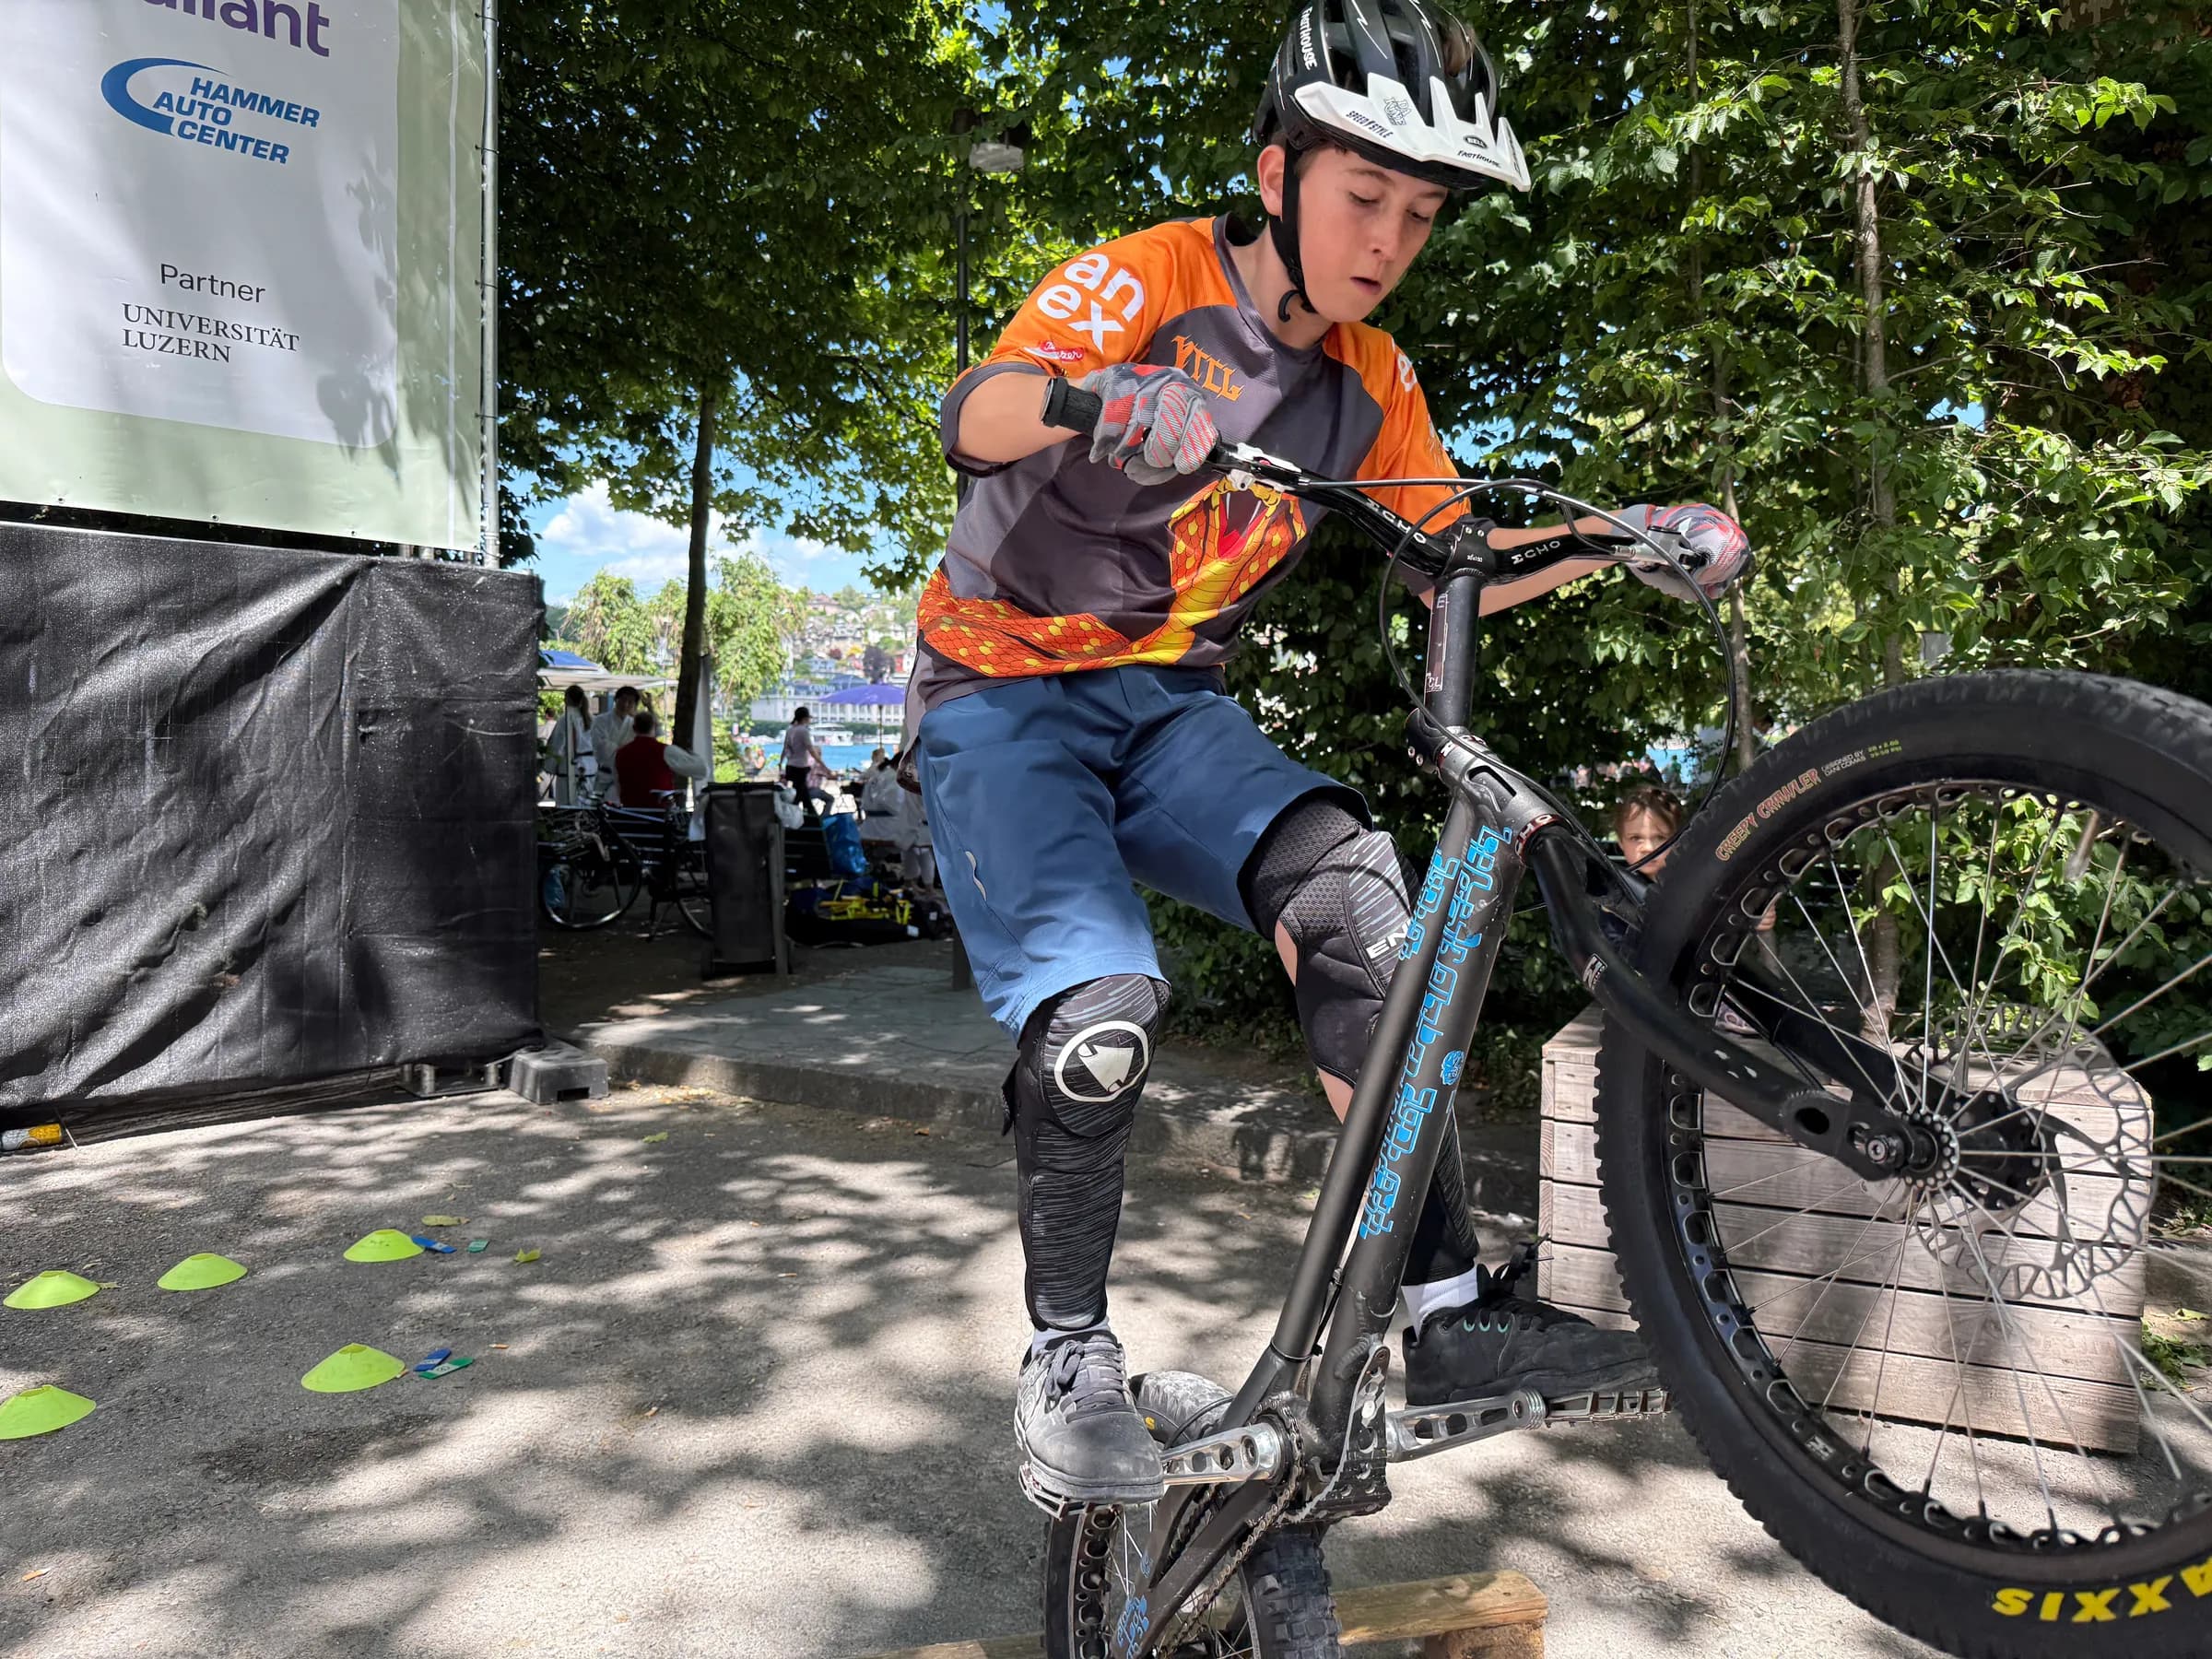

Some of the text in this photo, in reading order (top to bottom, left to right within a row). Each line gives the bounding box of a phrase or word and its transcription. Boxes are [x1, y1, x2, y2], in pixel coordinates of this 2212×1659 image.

[152, 91, 232, 126] AUTO
[190, 76, 321, 128] HAMMER
[177, 120, 290, 164] CENTER
[160, 263, 266, 303] Partner
[122, 303, 300, 351] UNIVERSITÄT
[122, 328, 231, 363] LUZERN
[1714, 768, 1822, 862] CREEPY CRAWLER
[1991, 1556, 2212, 1622] AXXIS
